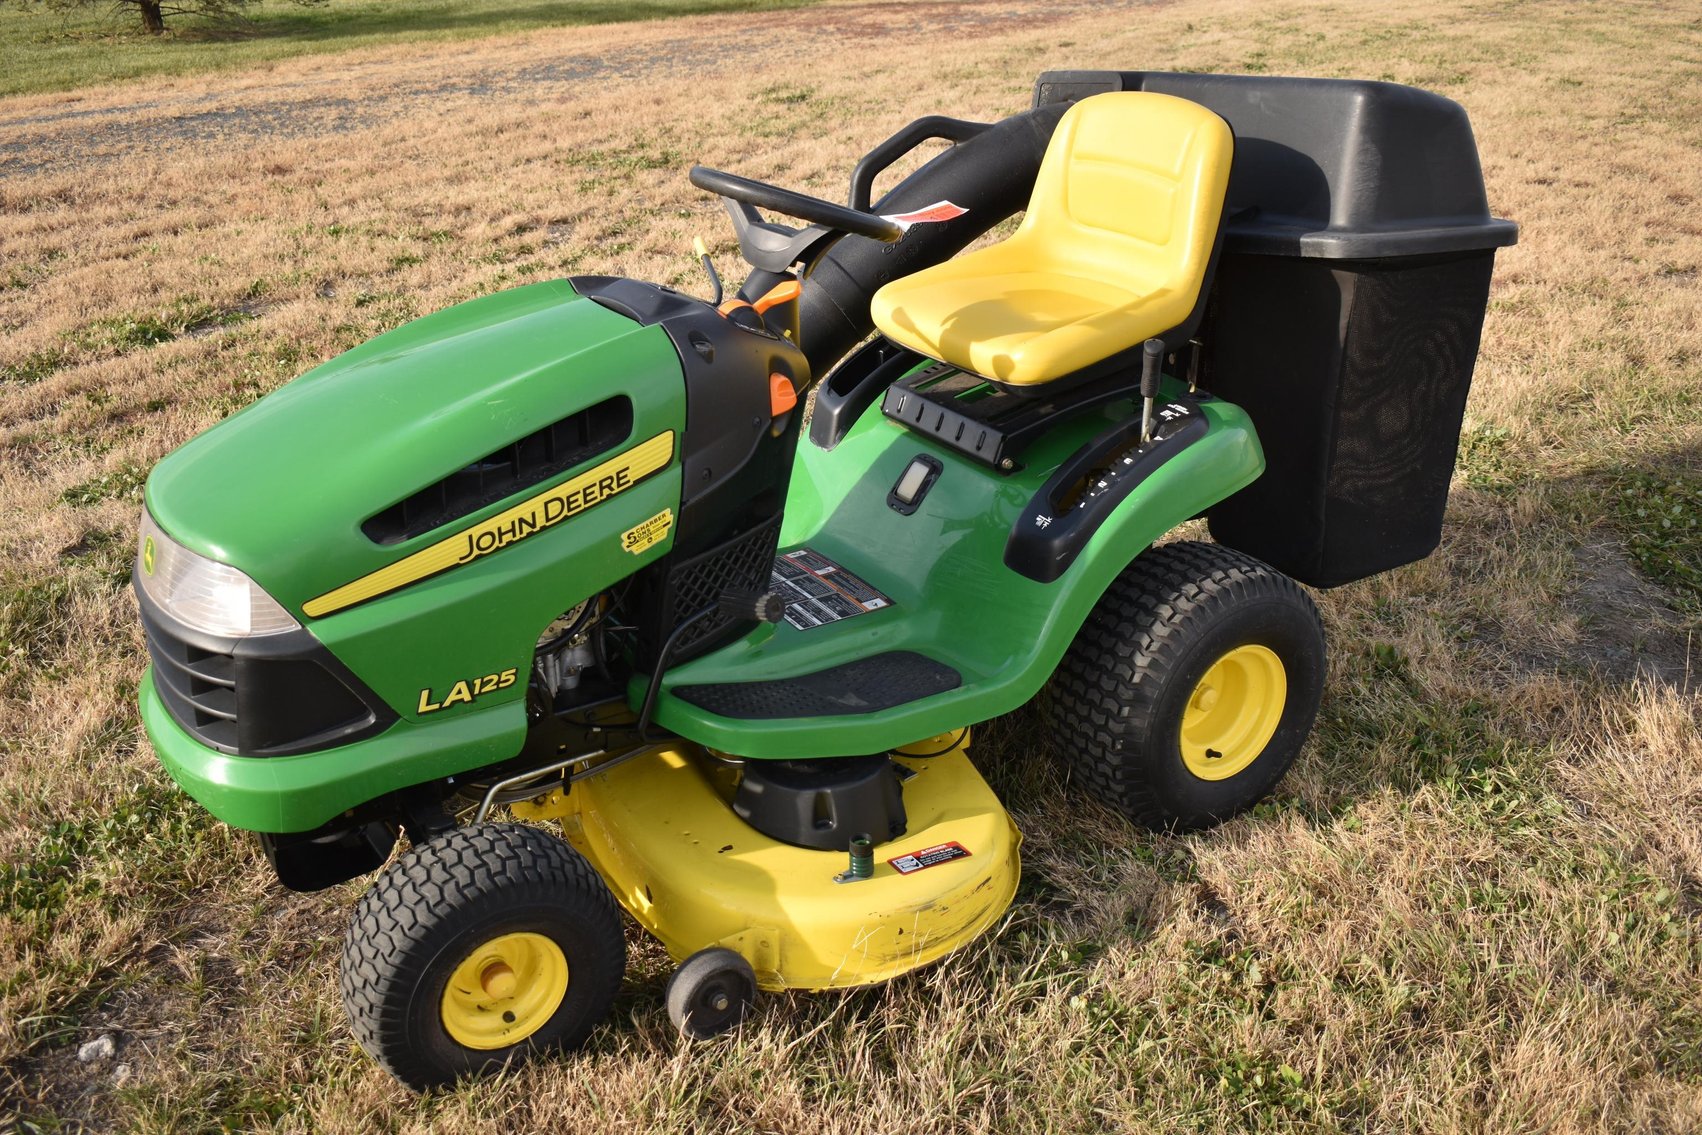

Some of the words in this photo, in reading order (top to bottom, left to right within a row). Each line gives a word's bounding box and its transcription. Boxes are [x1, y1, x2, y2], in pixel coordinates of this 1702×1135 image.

[459, 511, 537, 562] JOHN
[543, 466, 632, 524] DEERE
[417, 668, 518, 715] LA125
